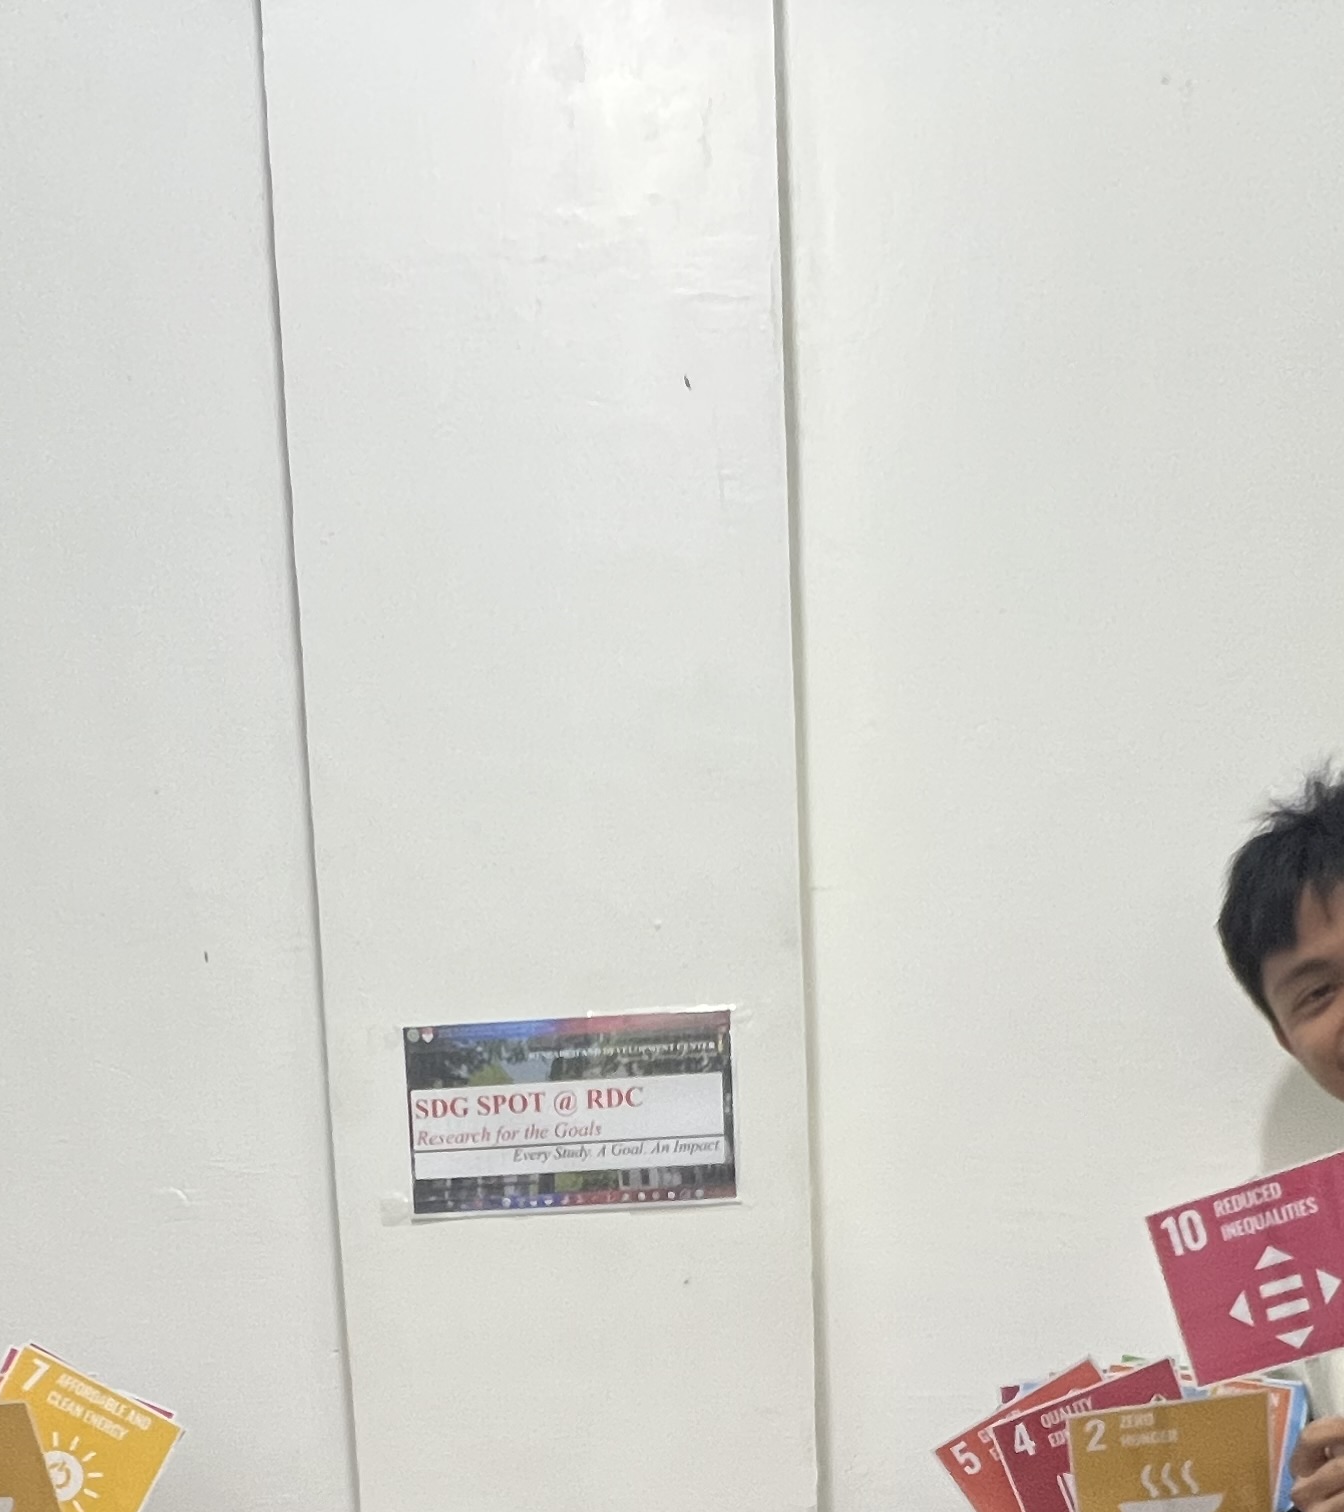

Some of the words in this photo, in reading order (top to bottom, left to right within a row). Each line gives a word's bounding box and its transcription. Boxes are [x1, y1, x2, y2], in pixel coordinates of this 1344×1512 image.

[415, 1097, 468, 1119] SDG
[477, 1092, 546, 1116] SPOT
[553, 1091, 577, 1116] @
[586, 1086, 644, 1110] RDC
[417, 1129, 490, 1147] Research
[495, 1125, 520, 1145] for
[524, 1123, 549, 1141] the
[555, 1120, 602, 1138] Goals
[513, 1148, 551, 1163] Every
[597, 1144, 607, 1157] A
[650, 1140, 671, 1155] An
[673, 1137, 720, 1155] Impact
[1159, 1208, 1208, 1256] 10
[1214, 1182, 1283, 1217] REDUCED
[1221, 1197, 1318, 1241] INEQUALITIES
[22, 1359, 51, 1391] 7
[55, 1373, 130, 1420] AFFORDABLE
[126, 1408, 154, 1432] AND
[46, 1391, 85, 1423] CLEAN
[83, 1409, 130, 1440] ENERGY
[1013, 1422, 1036, 1456] 4
[1040, 1396, 1094, 1429] QUALITY
[1083, 1419, 1107, 1452] 2
[950, 1440, 982, 1475] 5
